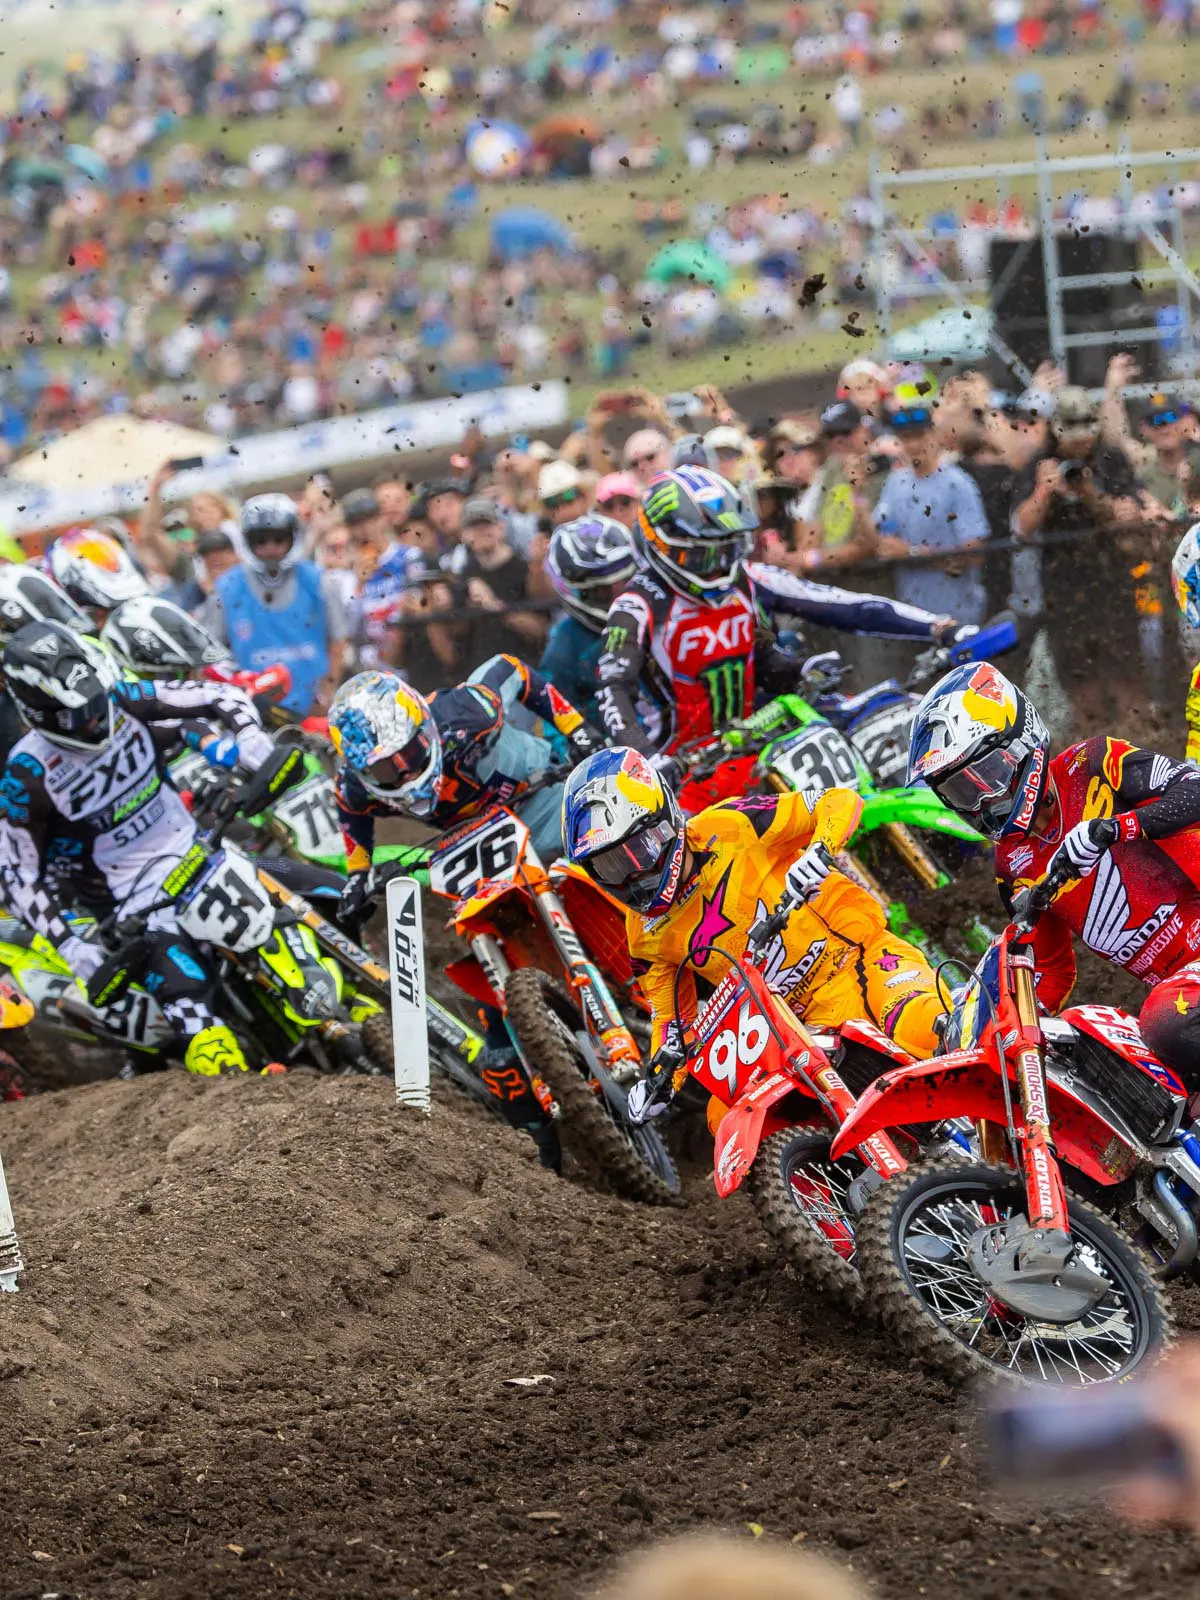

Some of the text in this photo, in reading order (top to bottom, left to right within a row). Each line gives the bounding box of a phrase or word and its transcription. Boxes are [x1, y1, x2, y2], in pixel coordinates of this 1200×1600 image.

[677, 613, 751, 662] FXR
[70, 732, 147, 815] FXR
[791, 731, 857, 791] 36
[443, 824, 518, 893] 26
[198, 868, 266, 946] 31
[1110, 903, 1177, 966] HONDA
[394, 929, 414, 1004] UFO
[411, 942, 421, 1008] PLAST
[692, 976, 731, 1031] RENTHAL
[698, 983, 736, 1038] RENTHAL
[709, 997, 770, 1099] 96
[1026, 1054, 1043, 1104] SHOWA
[1033, 1149, 1054, 1219] DUNLOP
